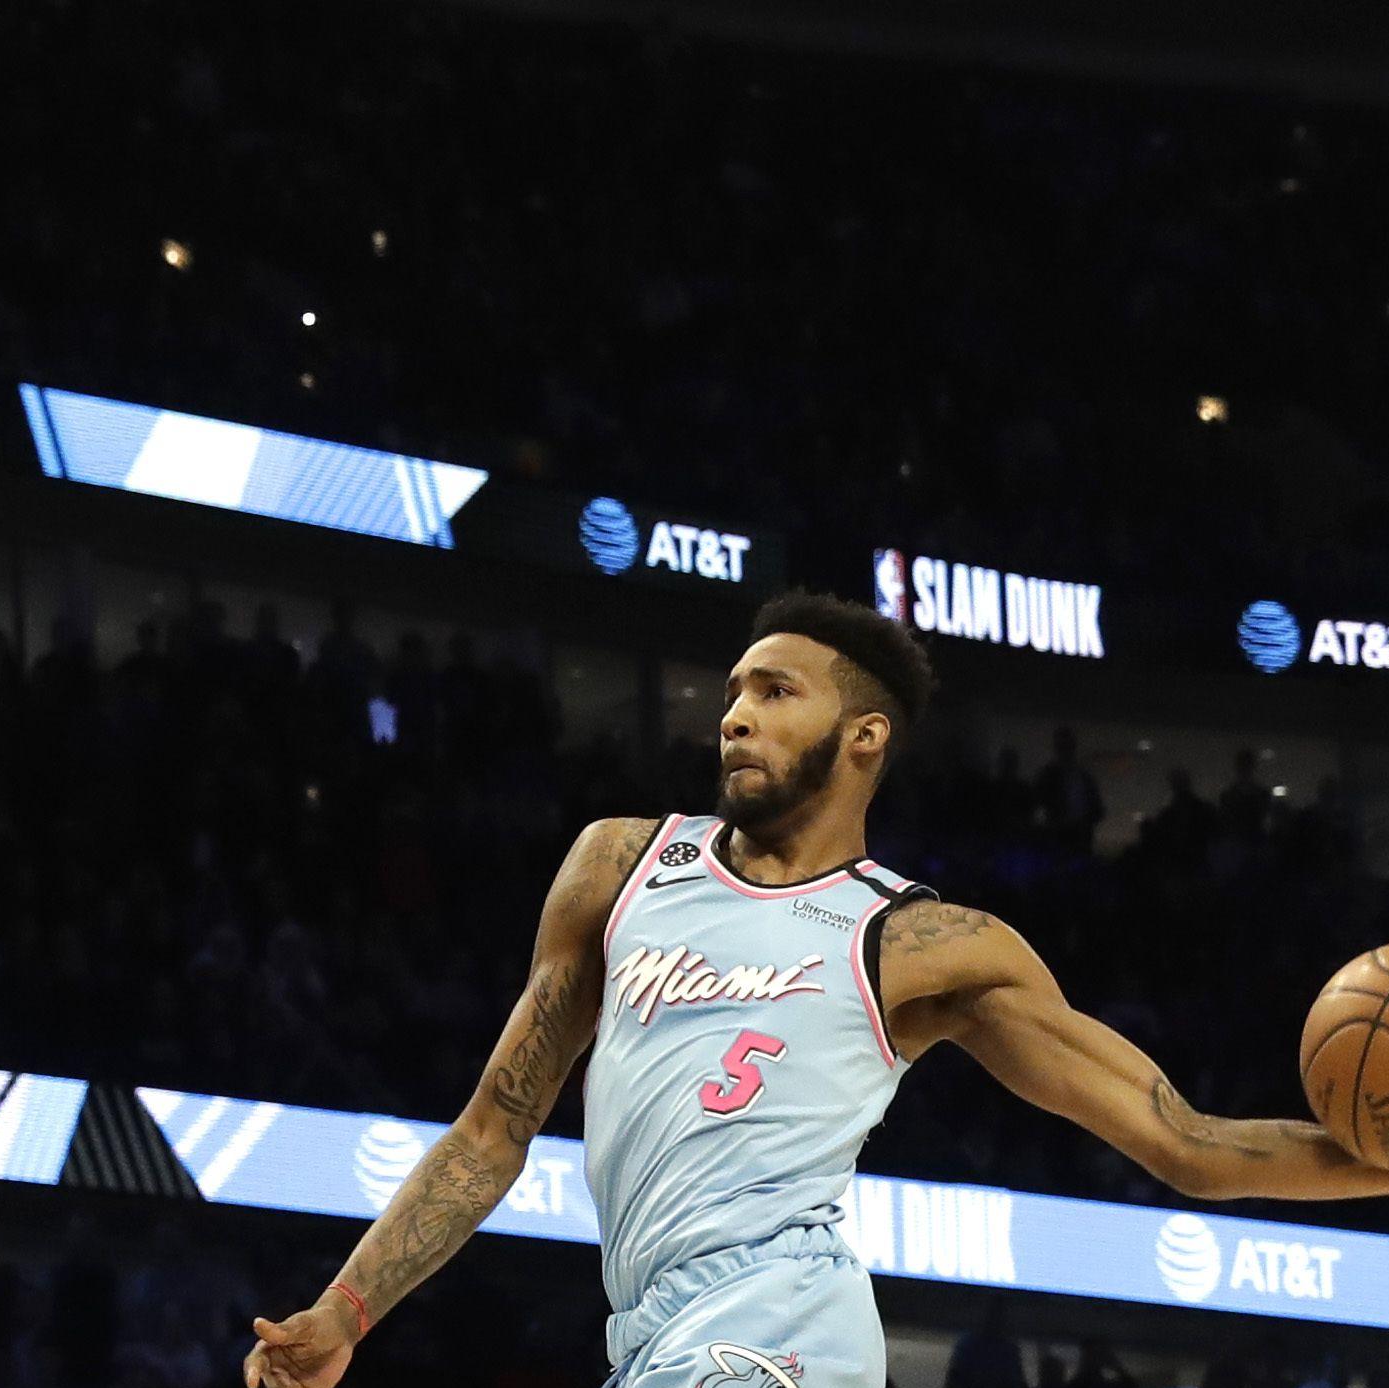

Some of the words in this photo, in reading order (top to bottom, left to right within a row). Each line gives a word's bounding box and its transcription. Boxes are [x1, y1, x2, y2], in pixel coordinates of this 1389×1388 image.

[646, 520, 751, 583] AT&T
[913, 557, 1001, 642] SLAM
[1006, 570, 1106, 659] DUNK
[793, 898, 856, 926] Ultimate
[612, 945, 825, 1027] Miami
[699, 1029, 787, 1120] 5
[902, 1182, 1016, 1284] DUNK
[1229, 1238, 1342, 1300] AT&T
